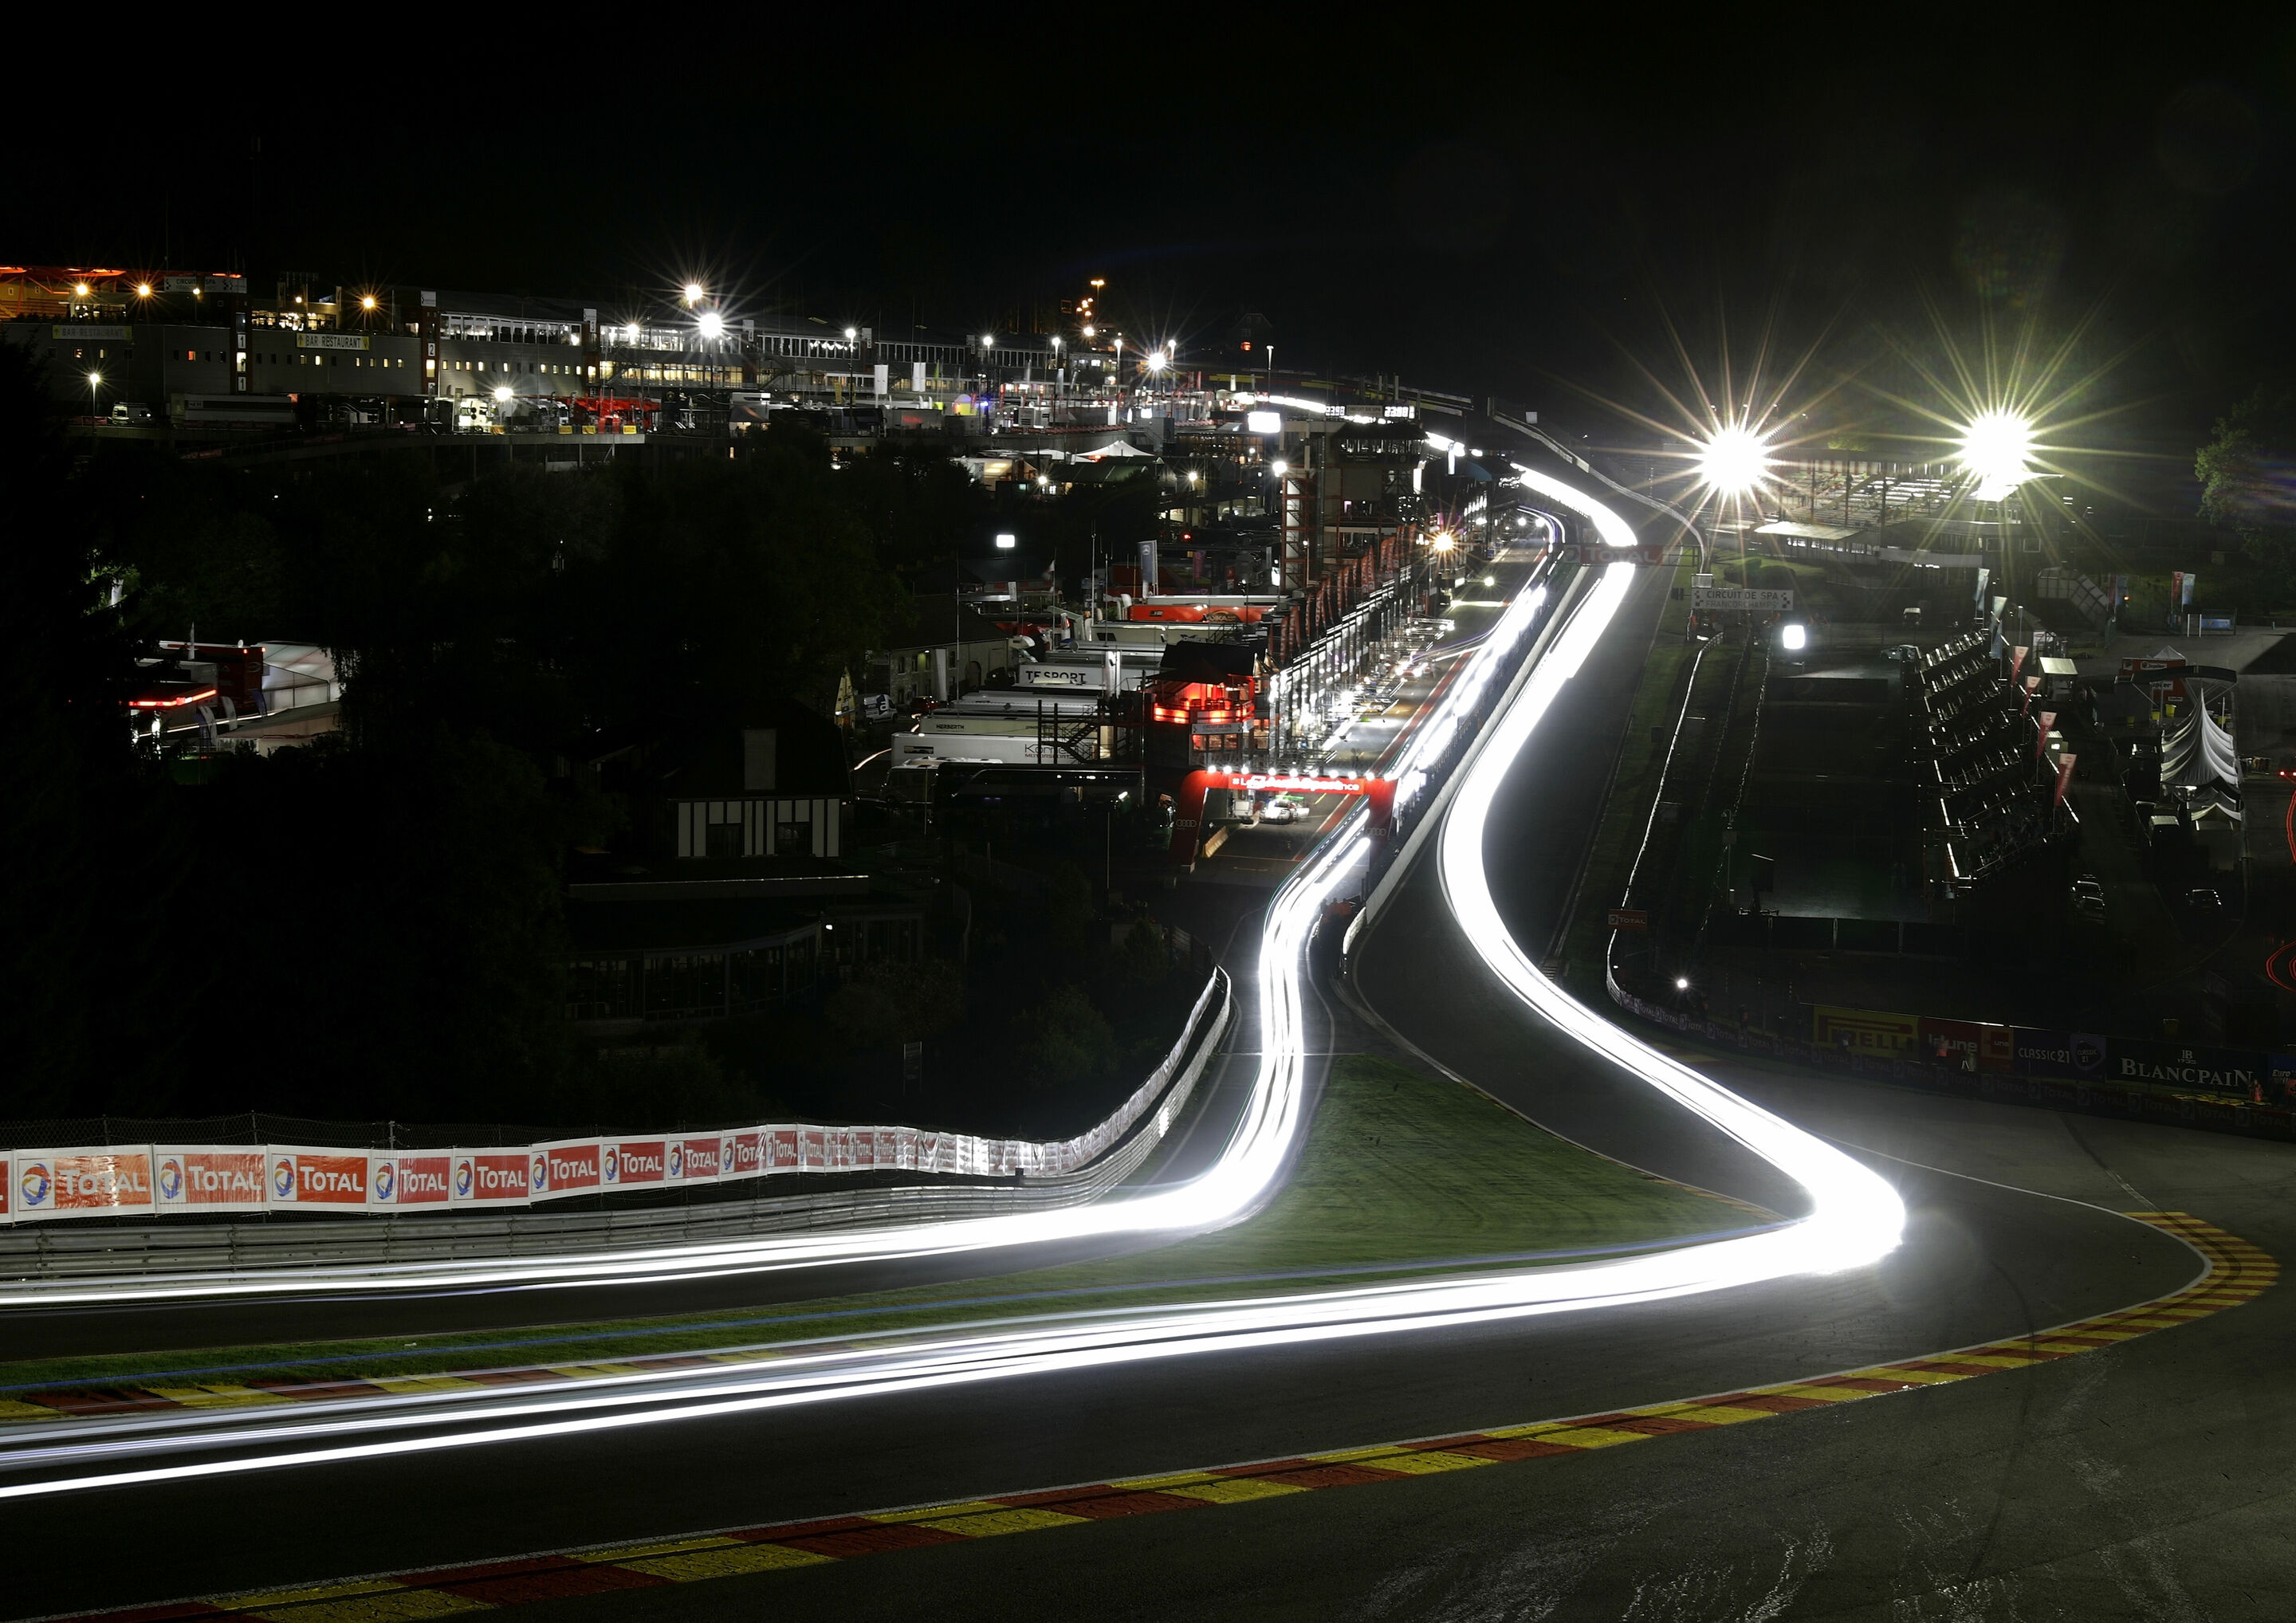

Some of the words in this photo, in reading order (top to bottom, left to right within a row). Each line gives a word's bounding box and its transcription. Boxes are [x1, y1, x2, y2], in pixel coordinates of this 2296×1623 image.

[305, 336, 318, 346] BAR
[322, 336, 360, 348] RESTAURANT
[1584, 546, 1657, 563] TOTAL
[1707, 590, 1742, 599] CIRCUIT
[1760, 591, 1779, 600] SPA
[1044, 672, 1087, 684] SPORT
[1661, 1011, 1680, 1026] TOTAL
[1685, 1019, 1707, 1034] TOTAL
[1783, 1045, 1811, 1059] TOTAL
[1823, 1052, 1850, 1066] TOTAL
[1863, 1058, 1893, 1072] TOTAL
[2119, 1057, 2255, 1087] BLANCPAIN
[1949, 1072, 1979, 1086] TOTAL
[1996, 1079, 2028, 1093] TOTAL
[2042, 1085, 2076, 1099] TOTAL
[2091, 1092, 2126, 1107] TOTAL
[2144, 1097, 2181, 1113] TOTAL
[2195, 1105, 2232, 1121] TOTAL
[2252, 1112, 2291, 1127] TOTAL
[736, 1144, 765, 1163] TOTAL
[775, 1139, 797, 1158] TOTAL
[805, 1139, 824, 1159] TOTAL
[855, 1139, 874, 1157] TOTAL
[621, 1153, 663, 1173] TOTAL
[685, 1149, 718, 1169] TOTAL
[477, 1166, 527, 1189] TOTAL
[551, 1158, 597, 1181] TOTAL
[60, 1169, 147, 1196] TOTAL
[188, 1165, 262, 1192] TOTAL
[300, 1166, 364, 1192] TOTAL
[400, 1169, 447, 1193] TOTAL
